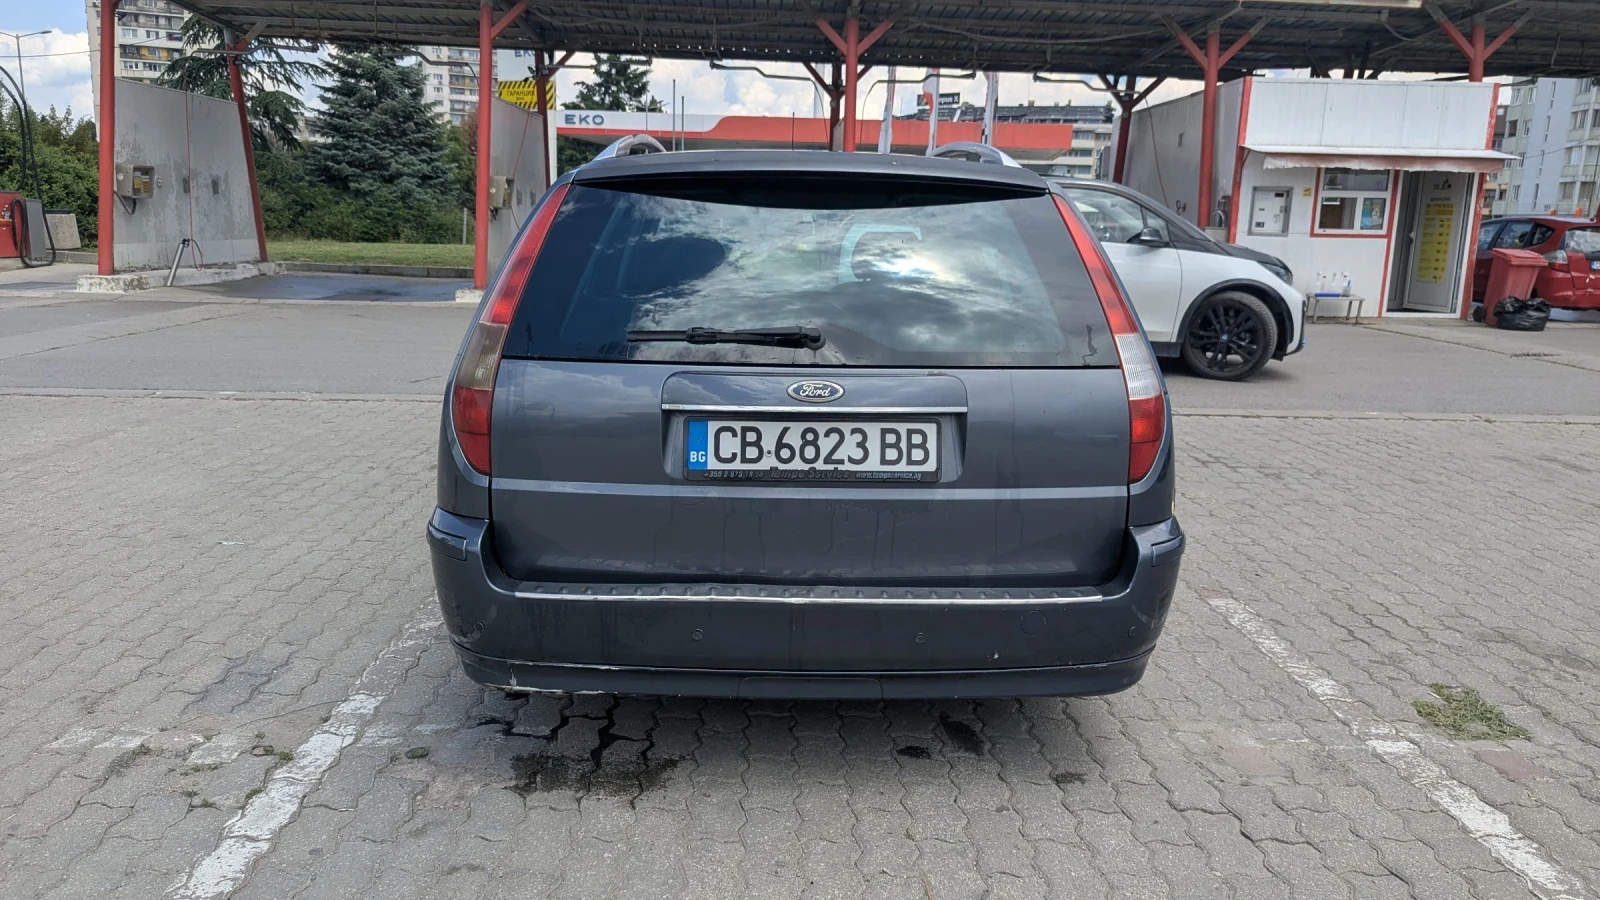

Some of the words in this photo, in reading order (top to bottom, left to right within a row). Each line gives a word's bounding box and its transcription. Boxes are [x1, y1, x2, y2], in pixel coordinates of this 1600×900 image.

[514, 49, 535, 57] EK
[564, 114, 605, 126] EKO
[800, 384, 831, 397] Ford
[774, 426, 870, 465] 6823
[880, 427, 930, 466] BB
[690, 451, 706, 462] BG
[769, 466, 805, 480] Tempo
[807, 466, 851, 479] Service
